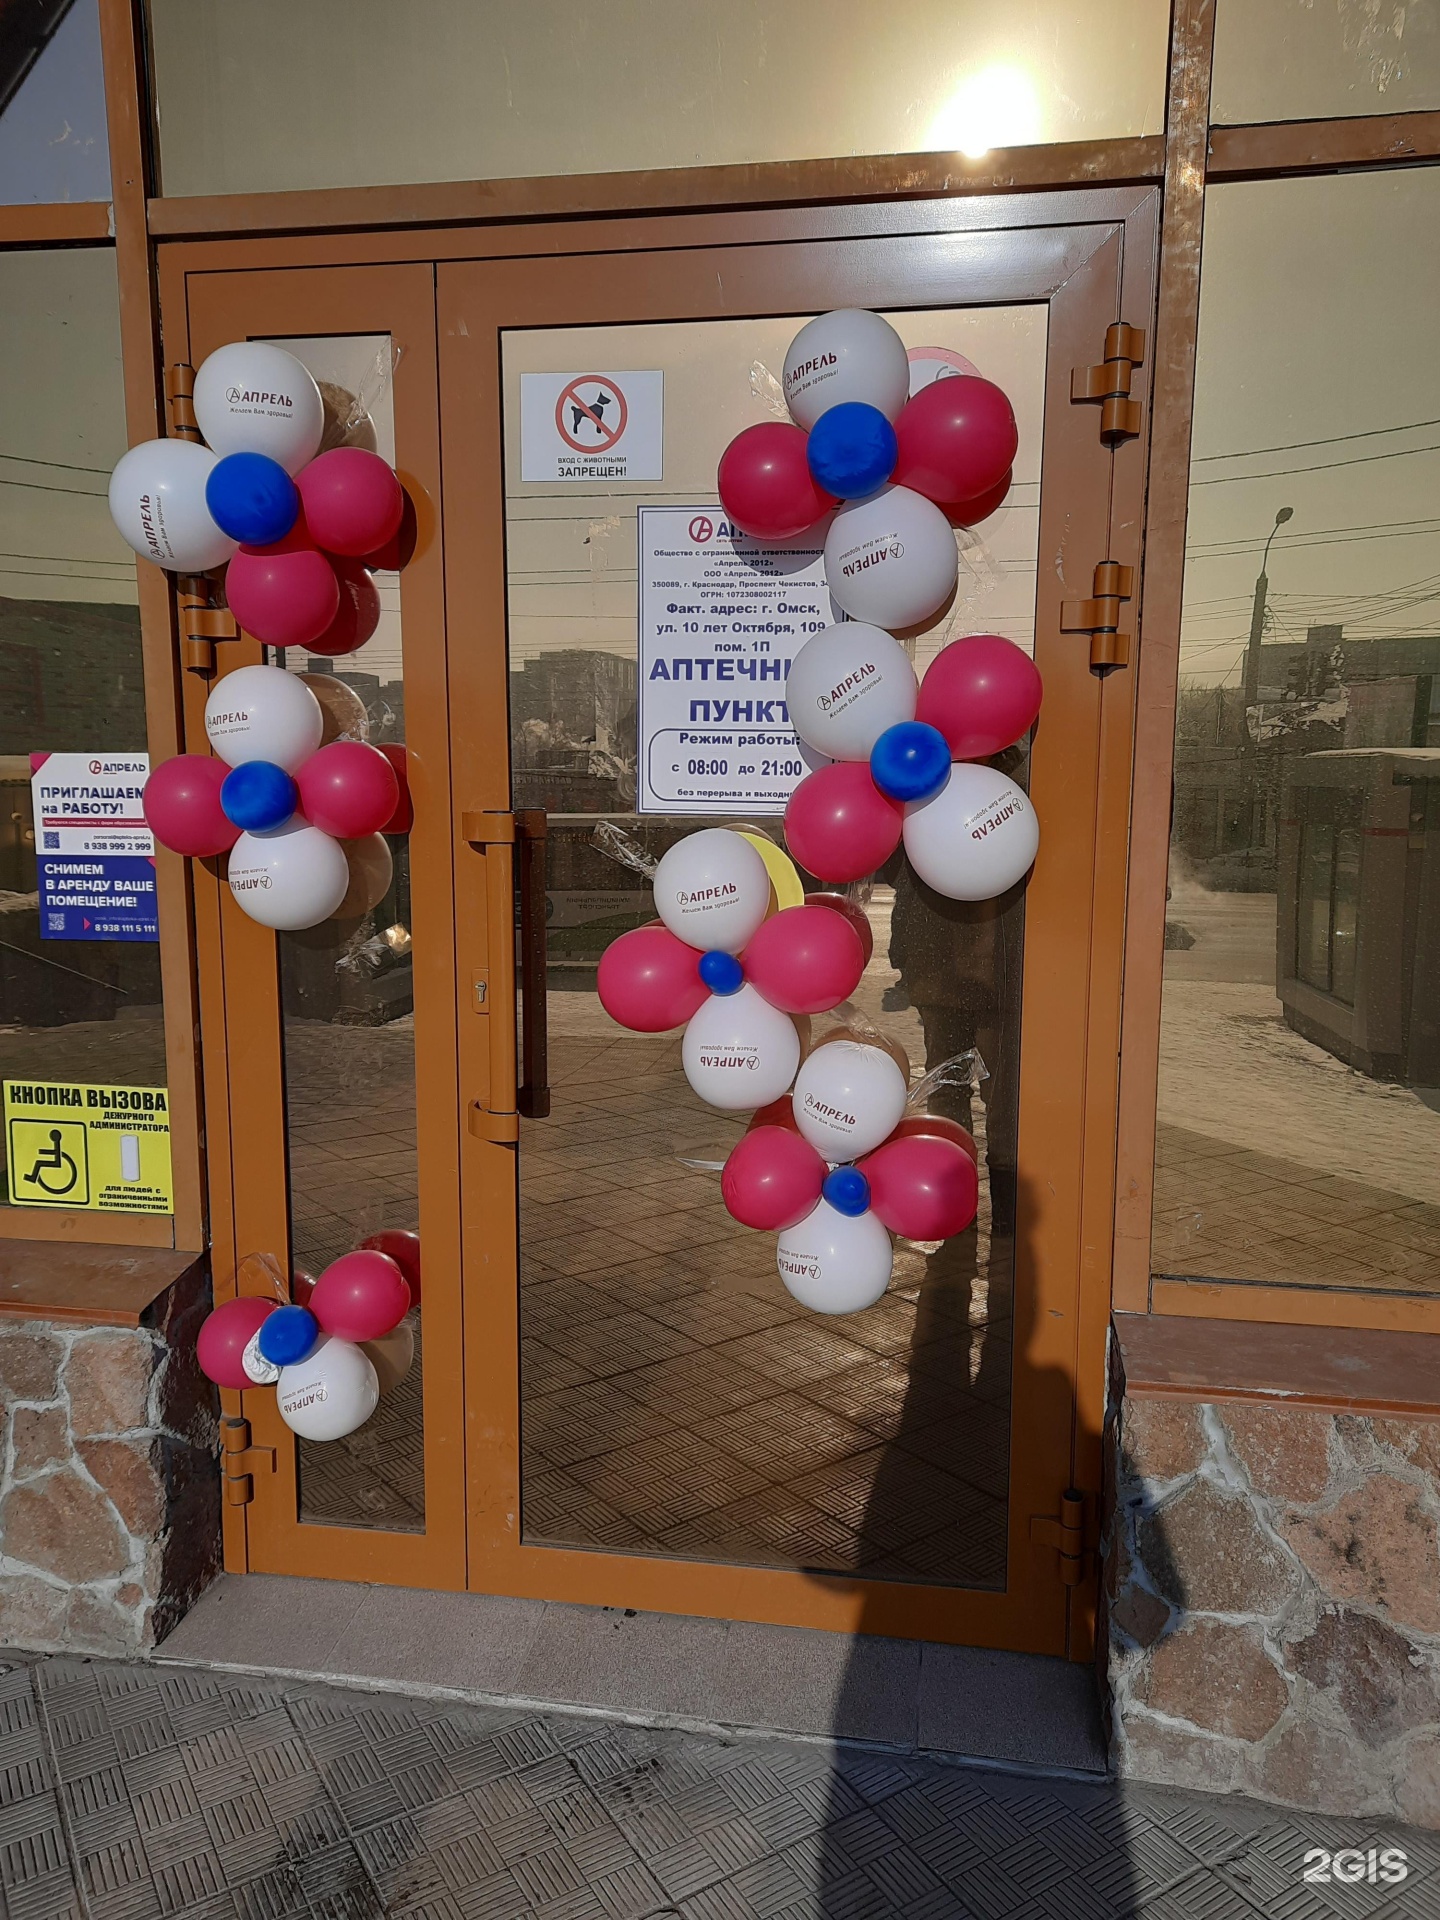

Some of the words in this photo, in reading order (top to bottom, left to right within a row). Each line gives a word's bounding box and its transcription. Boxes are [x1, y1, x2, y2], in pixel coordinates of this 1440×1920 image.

[793, 352, 837, 383] АПРЕЛЬ
[242, 391, 293, 407] АПРЕЛЬ
[558, 467, 627, 478] ЗАПРЕЩЕН!
[140, 495, 160, 548] АПРЕЛЬ
[875, 532, 898, 543] Желаем
[862, 541, 874, 549] Вам
[702, 549, 759, 557] ограниченной
[842, 548, 887, 577] АПРЕЛЬ
[666, 603, 705, 614] Факт.
[710, 604, 757, 616] адрес:
[762, 604, 772, 613] г.
[777, 603, 820, 615] Омск,
[656, 623, 677, 635] ул.
[683, 622, 698, 633] 10
[703, 624, 727, 633] лет
[732, 622, 795, 635] Октября,
[715, 643, 746, 652] пом.
[751, 641, 770, 651] 1П
[831, 663, 875, 702] АПРЕЛЬ
[829, 703, 848, 719] Желаем
[848, 694, 859, 704] Вам
[212, 712, 248, 726] АПРЕЛЬ
[679, 733, 732, 745] Режим
[738, 734, 800, 747] работы:
[103, 763, 146, 772] АПРЕЛЬ
[672, 764, 679, 772] с
[687, 759, 728, 776] 08:00
[738, 765, 755, 776] до
[761, 760, 802, 776] 21:00
[677, 789, 694, 797] без
[697, 790, 743, 798] перерыва
[42, 805, 57, 813] на
[62, 803, 123, 814] РАБОТУ!
[972, 803, 1014, 840] АПРЕЛЬ
[45, 864, 104, 874] СНИМЕМ
[46, 880, 54, 890] В
[57, 880, 111, 892] АРЕНДУ
[114, 881, 154, 891] ВАШЕ
[690, 882, 737, 902] АПРЕЛЬ
[47, 895, 137, 907] ПОМЕЩЕНИЕ!
[715, 897, 740, 908] здоровья!
[103, 924, 119, 932] 938
[700, 1056, 746, 1067] АПРЕЛЬ
[10, 1085, 83, 1107] КНОПКА
[87, 1089, 167, 1111] ВЫЗОВА
[103, 1112, 154, 1121] ДЕЖУРНОГО
[813, 1101, 856, 1125] АПРЕЛЬ
[89, 1121, 169, 1132] АДМИНИСТРАТОРА
[99, 1193, 168, 1202] ограниченными
[99, 1201, 168, 1210] возможностями
[284, 1394, 315, 1414] АПРЕЛЬ
